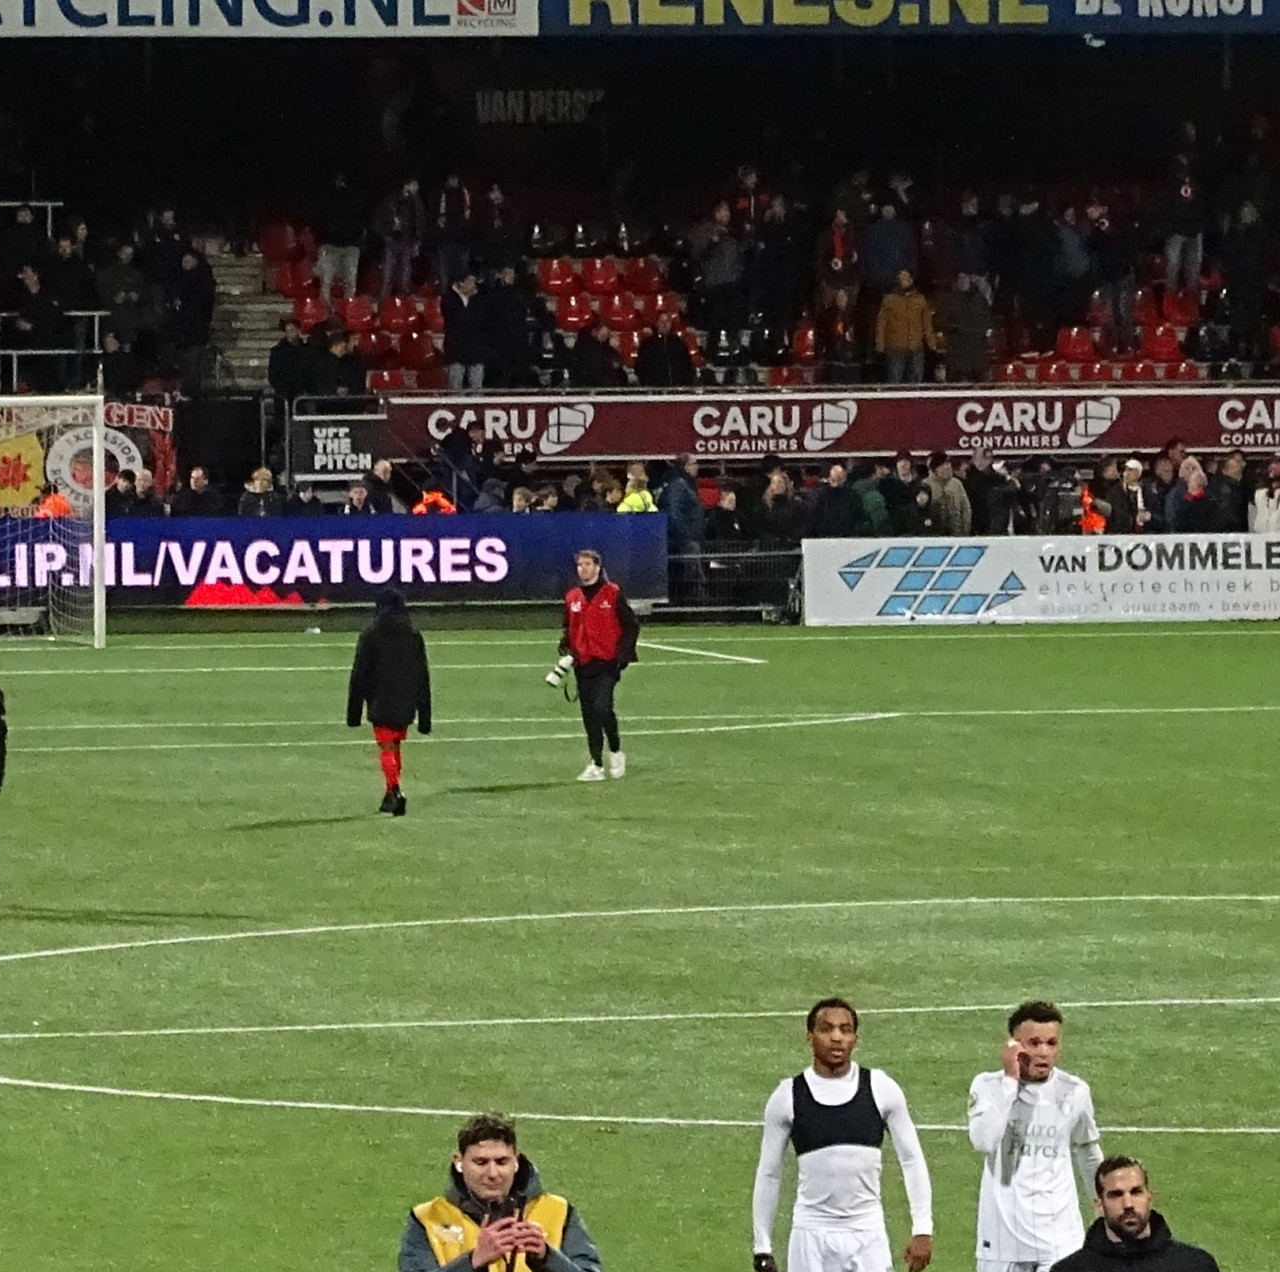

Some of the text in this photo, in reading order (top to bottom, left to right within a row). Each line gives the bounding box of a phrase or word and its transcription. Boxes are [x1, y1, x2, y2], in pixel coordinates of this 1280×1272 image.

[692, 405, 800, 436] CARU
[956, 401, 1063, 433] CARU
[314, 438, 352, 454] THE
[695, 438, 799, 453] CONTAINERS
[958, 435, 1062, 449] CONTAINERS
[314, 453, 372, 470] PITCH
[1038, 554, 1087, 573] VAN
